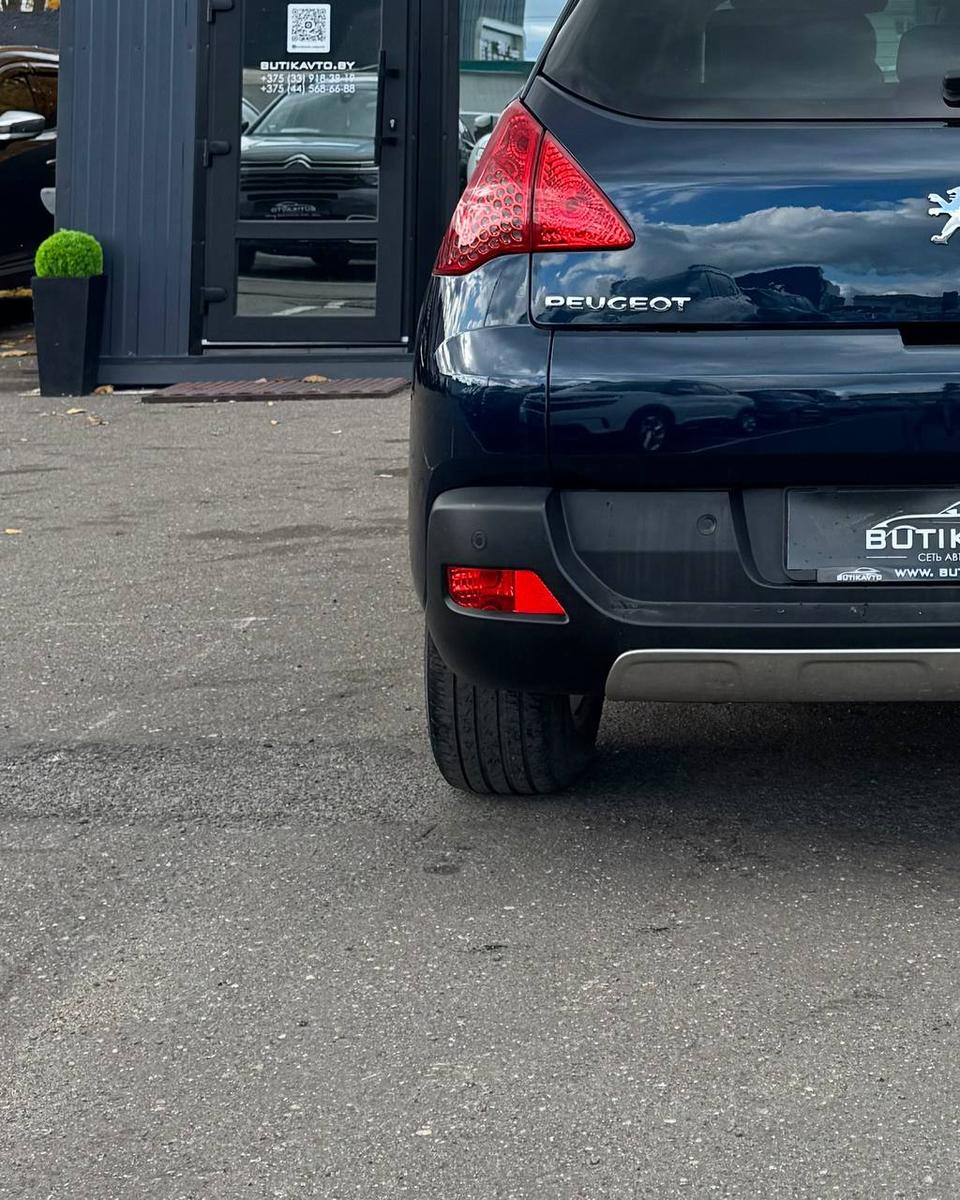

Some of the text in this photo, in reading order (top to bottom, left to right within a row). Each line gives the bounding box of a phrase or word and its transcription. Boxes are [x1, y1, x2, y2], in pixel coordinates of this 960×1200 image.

[260, 61, 356, 70] BUTIKAVTO.BY
[260, 73, 285, 84] +375
[287, 72, 306, 84] (33)
[260, 83, 356, 96] +375 (44) 568-66-88
[544, 295, 691, 312] PEUGEOT
[917, 553, 942, 562] СЕТЬ
